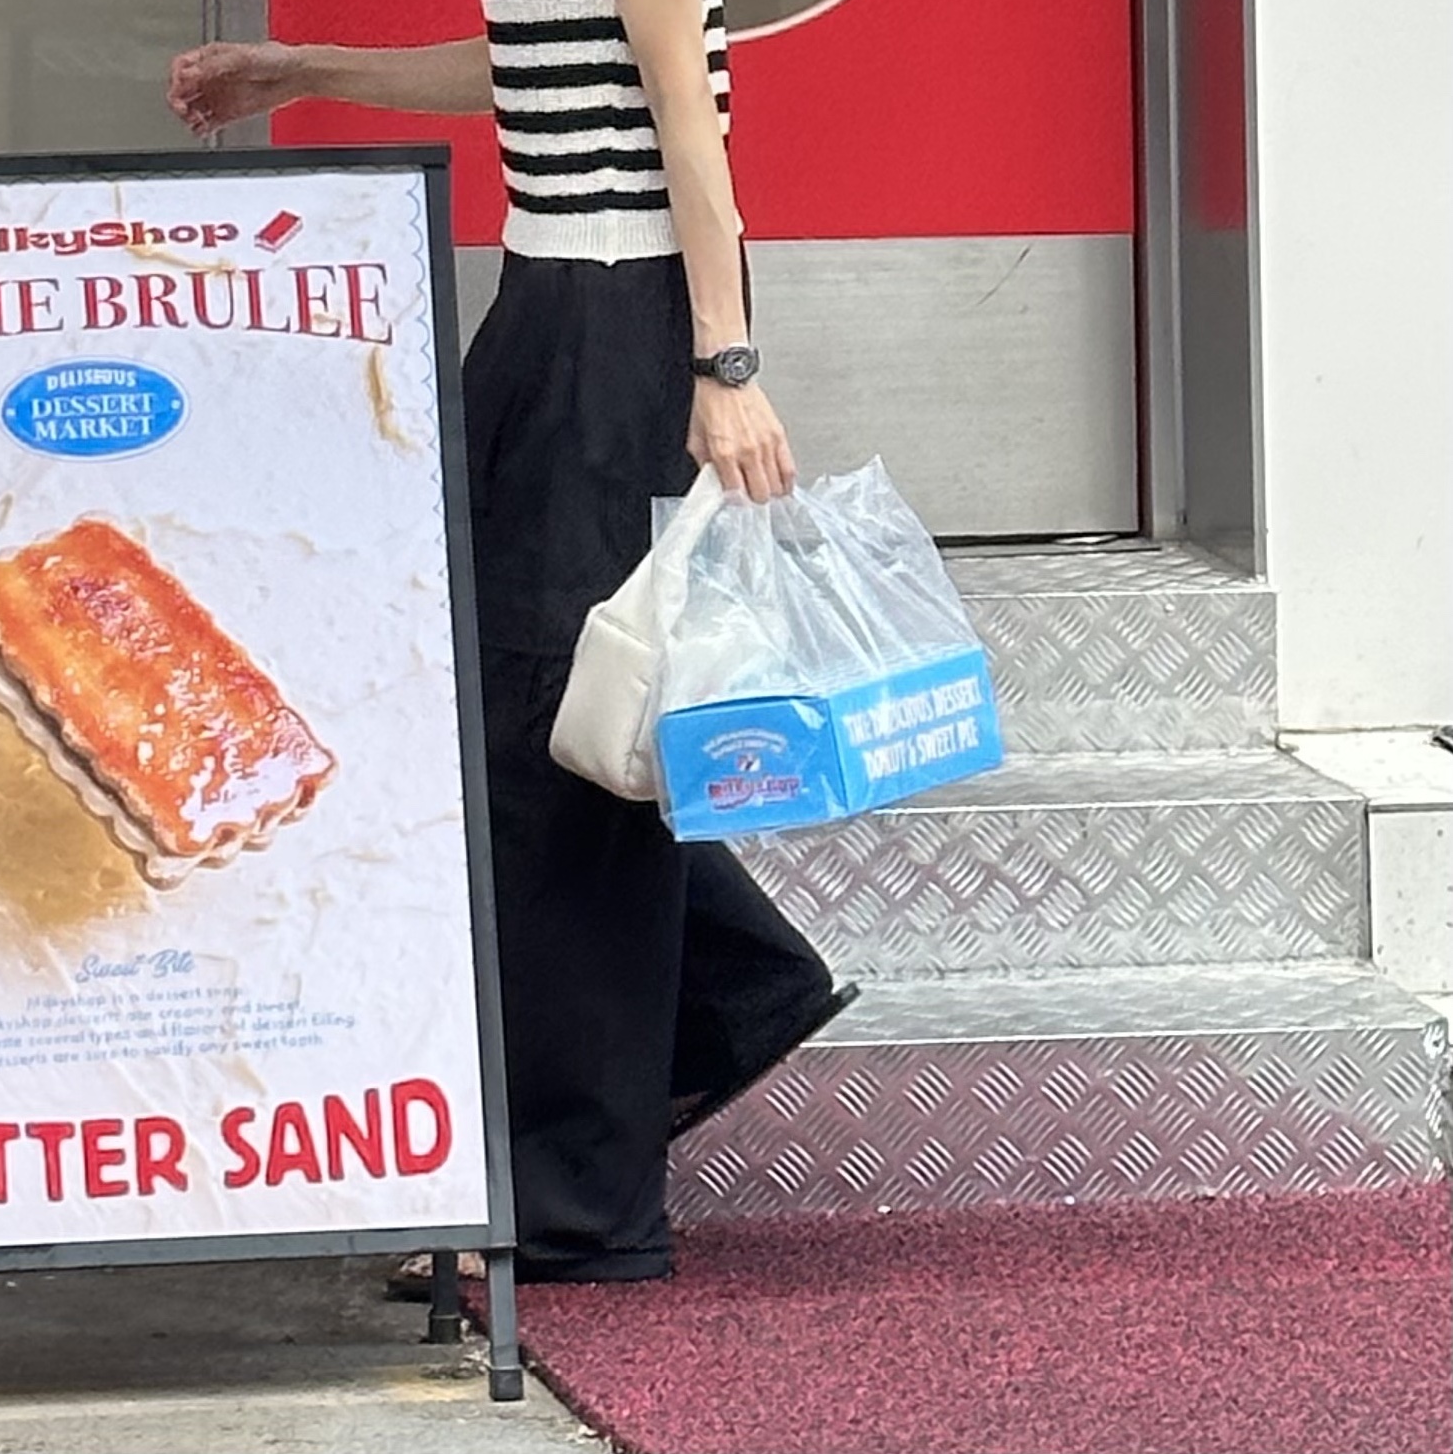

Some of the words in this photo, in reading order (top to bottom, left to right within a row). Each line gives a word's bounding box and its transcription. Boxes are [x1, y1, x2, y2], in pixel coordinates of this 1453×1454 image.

[80, 262, 395, 346] BRULEE
[31, 392, 155, 418] DESSERT
[35, 416, 155, 442] MARKET
[75, 953, 146, 983] Sweet
[221, 1077, 452, 1189] SAND
